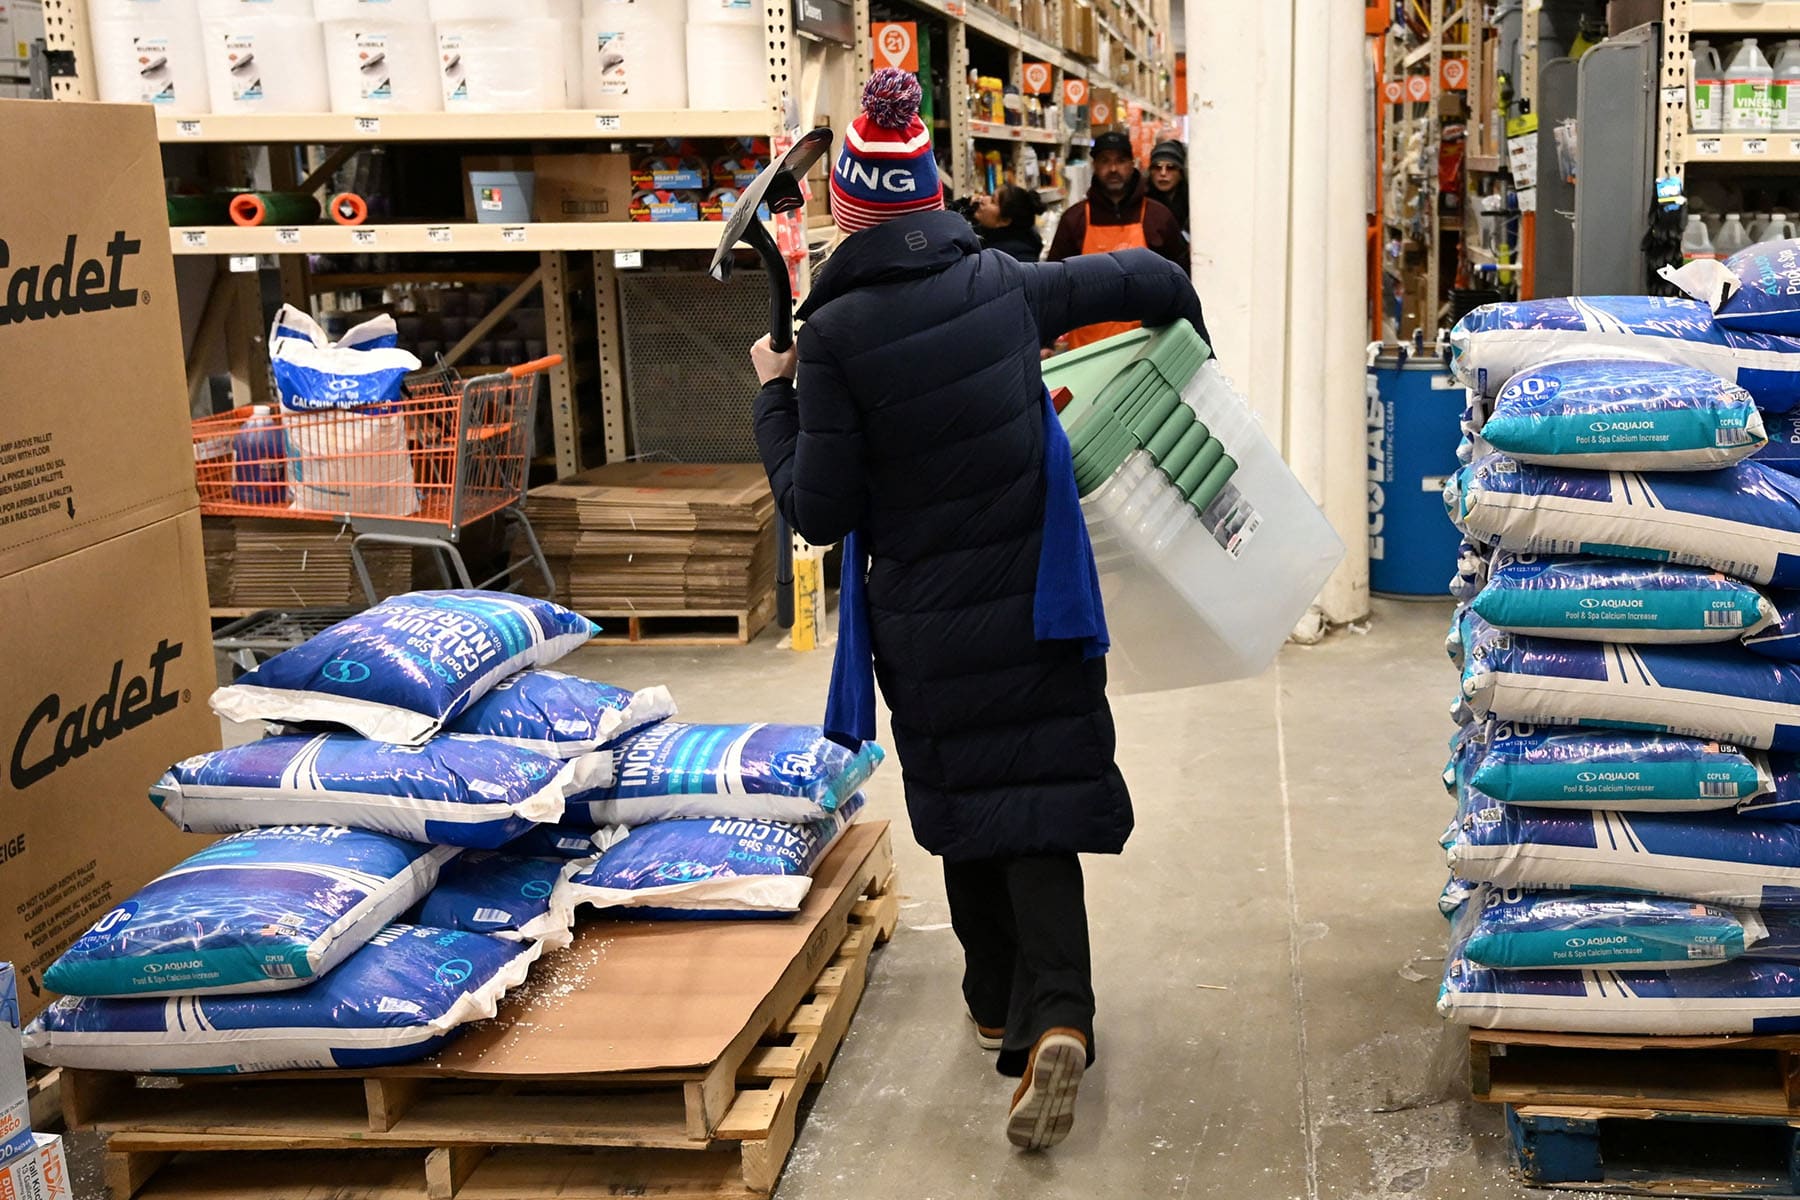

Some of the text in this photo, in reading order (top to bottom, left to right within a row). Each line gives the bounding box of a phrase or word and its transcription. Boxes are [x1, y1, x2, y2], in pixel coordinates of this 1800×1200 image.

[887, 37, 904, 51] 21
[1611, 421, 1654, 430] AQUAJOE
[14, 438, 33, 449] ABOVE
[34, 432, 52, 444] PALLET
[1576, 433, 1670, 445] Pool & Spa Calcium Increaser
[17, 451, 32, 461] WITH
[33, 445, 50, 457] FLOOR
[1386, 433, 1394, 482] SCIENTIFIC
[34, 464, 46, 473] RAS
[47, 462, 55, 470] DU
[56, 459, 66, 468] SOL
[33, 478, 40, 486] LA
[41, 471, 64, 483] PALETTE
[39, 493, 45, 502] DE
[46, 491, 54, 500] LA
[54, 485, 73, 497] PALETA
[16, 511, 28, 521] RAS
[28, 507, 41, 517] CON
[41, 504, 48, 513] EL
[1601, 599, 1643, 608] AQUAJOE
[1566, 611, 1658, 621] Pool & Spa Calcium Increaser
[382, 615, 479, 672] CALCIUM
[406, 637, 432, 653] Spa
[442, 655, 467, 680] Pool
[10, 639, 183, 790] Cadet
[1720, 745, 1738, 754] USA
[1598, 771, 1640, 781] AQUAJOE
[1585, 785, 1597, 794] Spa
[1598, 784, 1623, 792] Calcium
[1624, 784, 1655, 792] Increaser
[708, 819, 809, 858] CALCIUM
[739, 838, 763, 852] Spa
[777, 846, 802, 866] Pool
[76, 859, 97, 877] PALLET
[76, 873, 95, 889] FLOOR
[88, 892, 111, 911] PALETTE
[1587, 935, 1628, 945] AQUAJOE
[1553, 950, 1566, 959] Pool
[1574, 950, 1587, 959] Spa
[1587, 948, 1612, 957] Calcium
[1613, 947, 1643, 956] Increaser
[22, 1164, 29, 1173] 13
[41, 1143, 65, 1200] HDX
[29, 1157, 44, 1200] Tall Kitc
